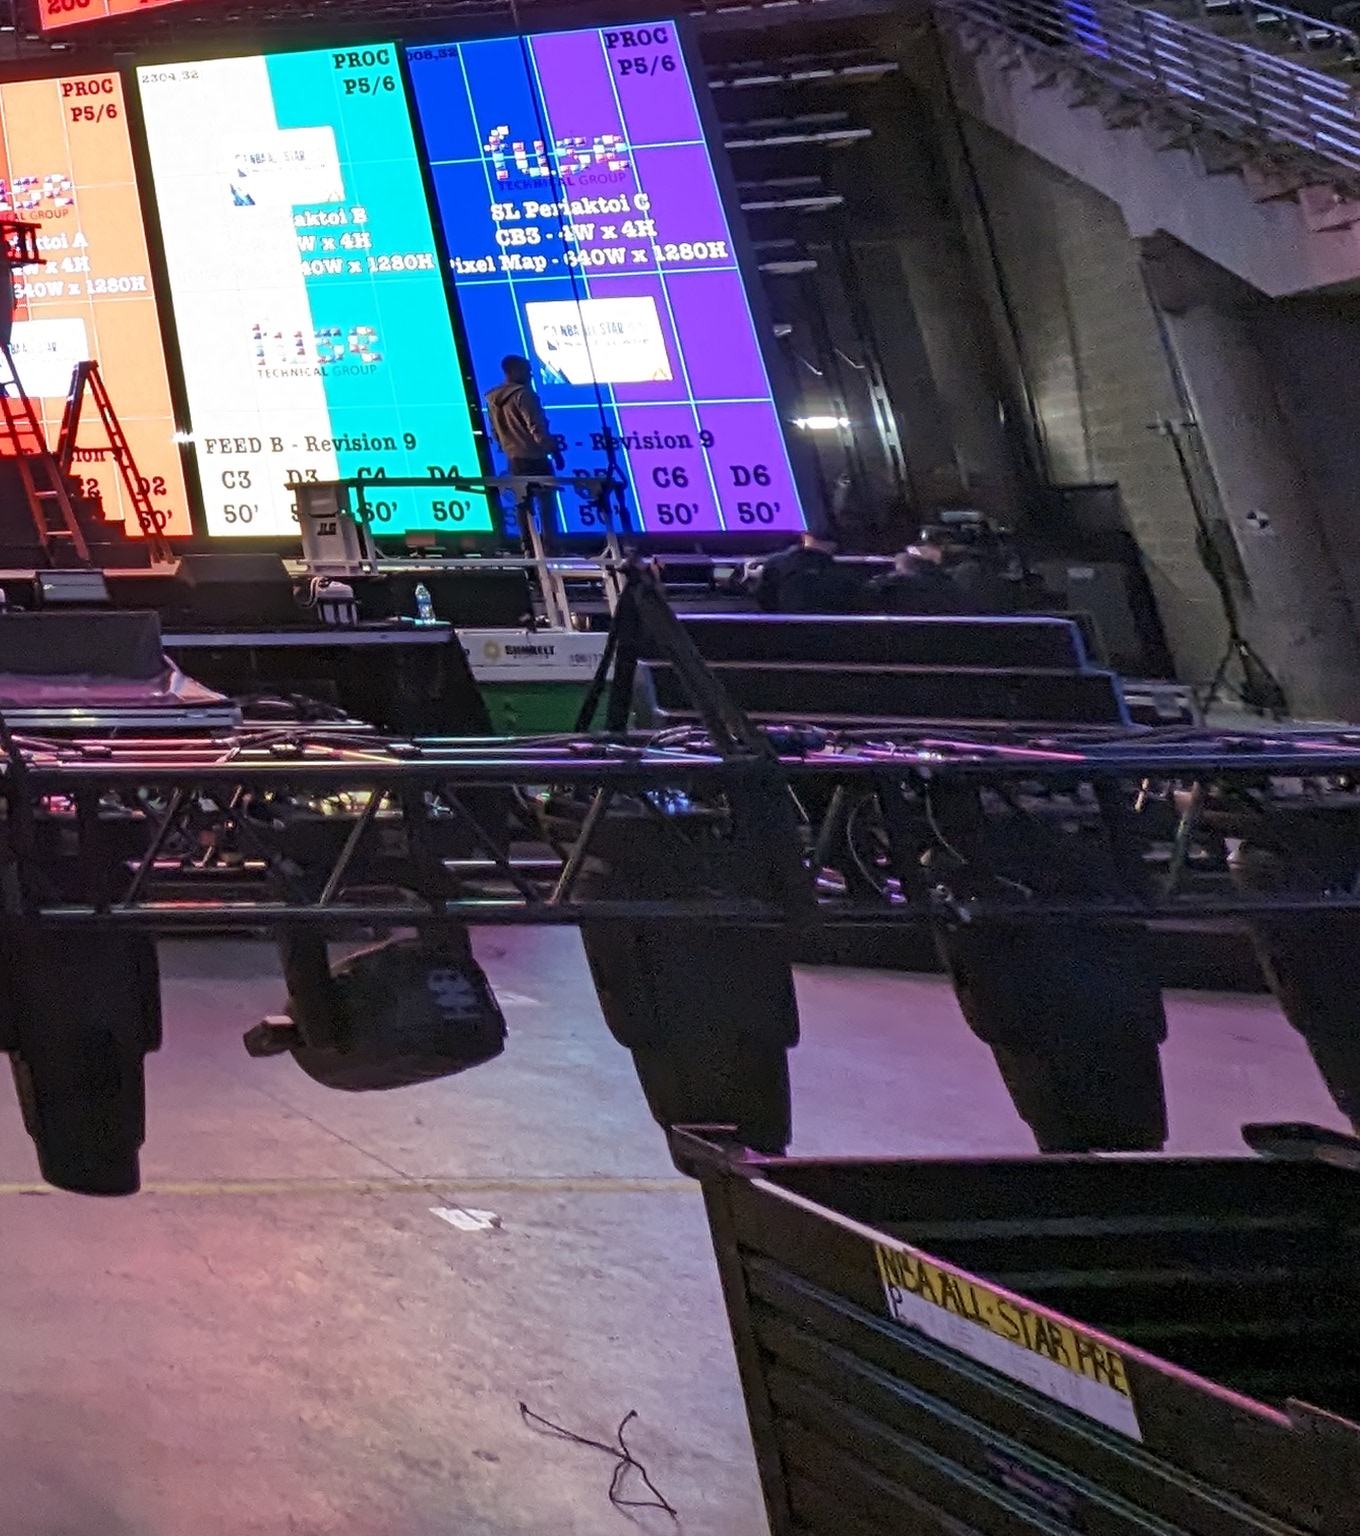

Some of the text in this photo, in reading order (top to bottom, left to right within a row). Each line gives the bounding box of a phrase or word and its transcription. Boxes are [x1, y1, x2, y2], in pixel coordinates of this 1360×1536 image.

[605, 27, 668, 49] PROC
[333, 49, 390, 70] PROC
[619, 55, 677, 76] P5/6
[62, 78, 114, 97] PROC
[343, 75, 396, 95] P5/6
[71, 104, 118, 124] P5/6
[491, 194, 631, 222] SL Periaktoi
[495, 227, 541, 247] CB3
[366, 253, 435, 272] 1280H
[499, 240, 728, 273] Map 1280H
[86, 276, 147, 295] 1280H
[332, 364, 378, 376] GROUP
[205, 432, 417, 455] FEED Revision 9
[221, 470, 252, 489] C3
[652, 466, 689, 489] C6
[730, 464, 772, 487] D6
[432, 501, 472, 522] 50'
[656, 502, 699, 525] 50'
[736, 502, 781, 524] 50'
